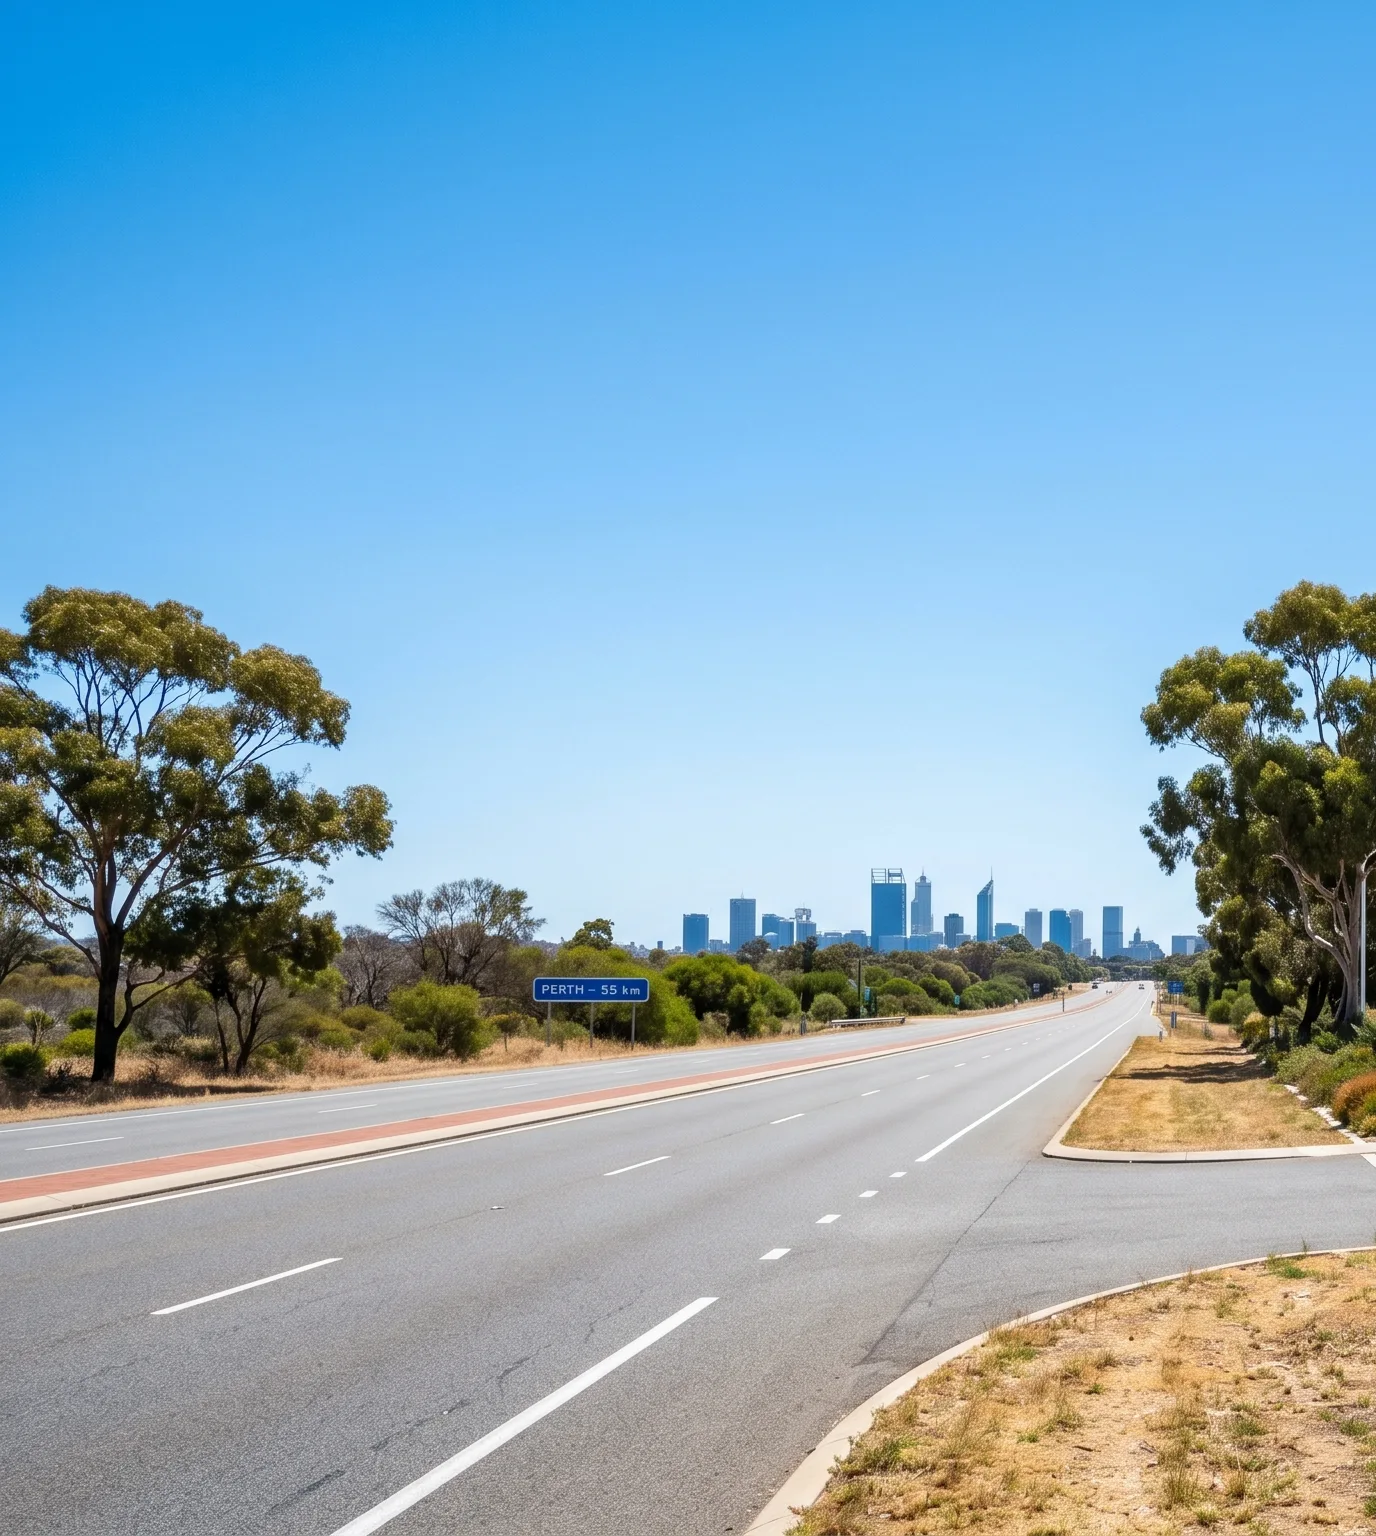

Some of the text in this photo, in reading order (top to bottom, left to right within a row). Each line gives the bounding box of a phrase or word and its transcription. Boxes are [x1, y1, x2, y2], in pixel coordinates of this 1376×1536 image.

[541, 984, 584, 995] PERTH
[601, 985, 617, 995] 55
[622, 985, 640, 995] km
